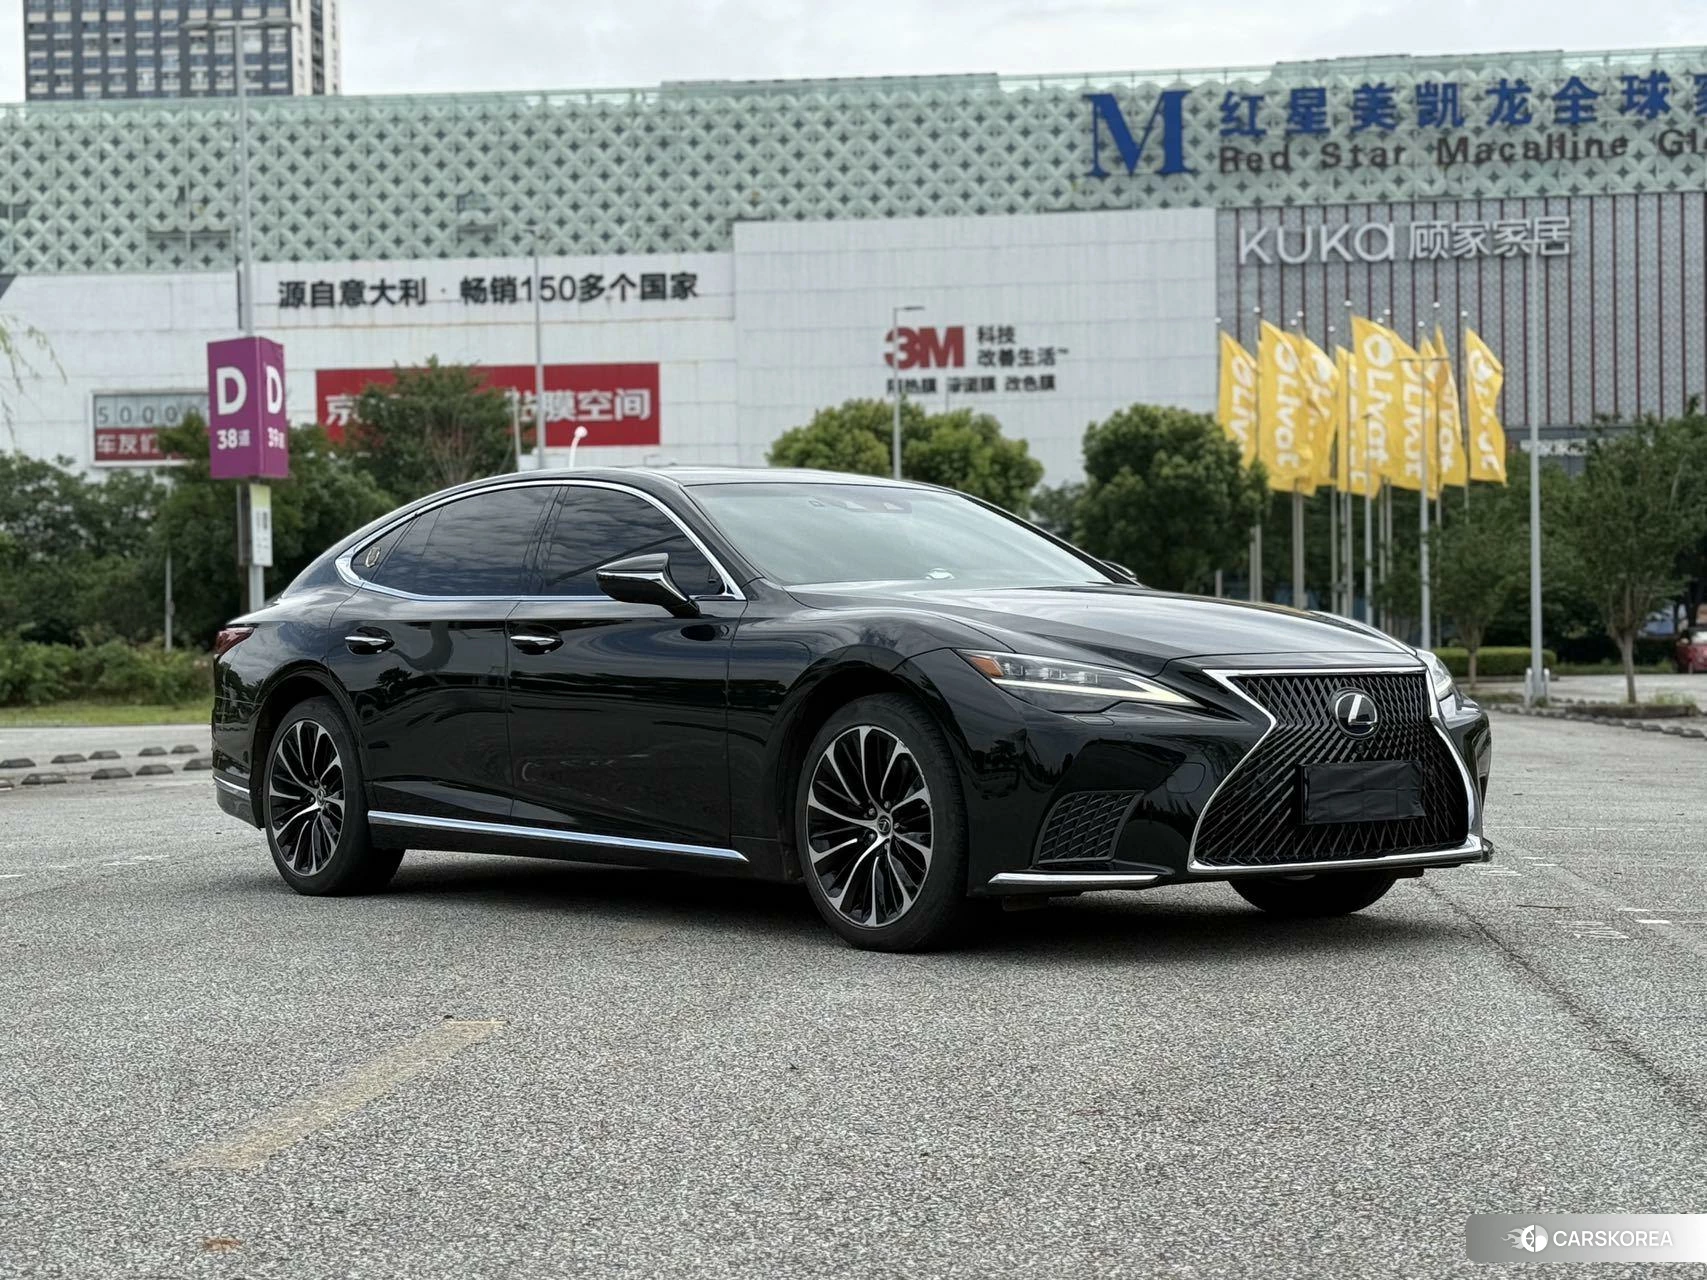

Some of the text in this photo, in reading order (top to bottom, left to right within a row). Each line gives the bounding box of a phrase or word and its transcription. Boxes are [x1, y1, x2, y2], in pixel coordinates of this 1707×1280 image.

[1083, 90, 1198, 177] M
[1219, 129, 1707, 174] Red Star Macalline Gl
[1408, 215, 1571, 261] 顾家家居
[278, 272, 698, 309] 源自意大利 畅销150多个国家
[884, 326, 965, 370] 3M
[977, 325, 1016, 345] 科技
[216, 366, 247, 416] D
[265, 365, 283, 415] D
